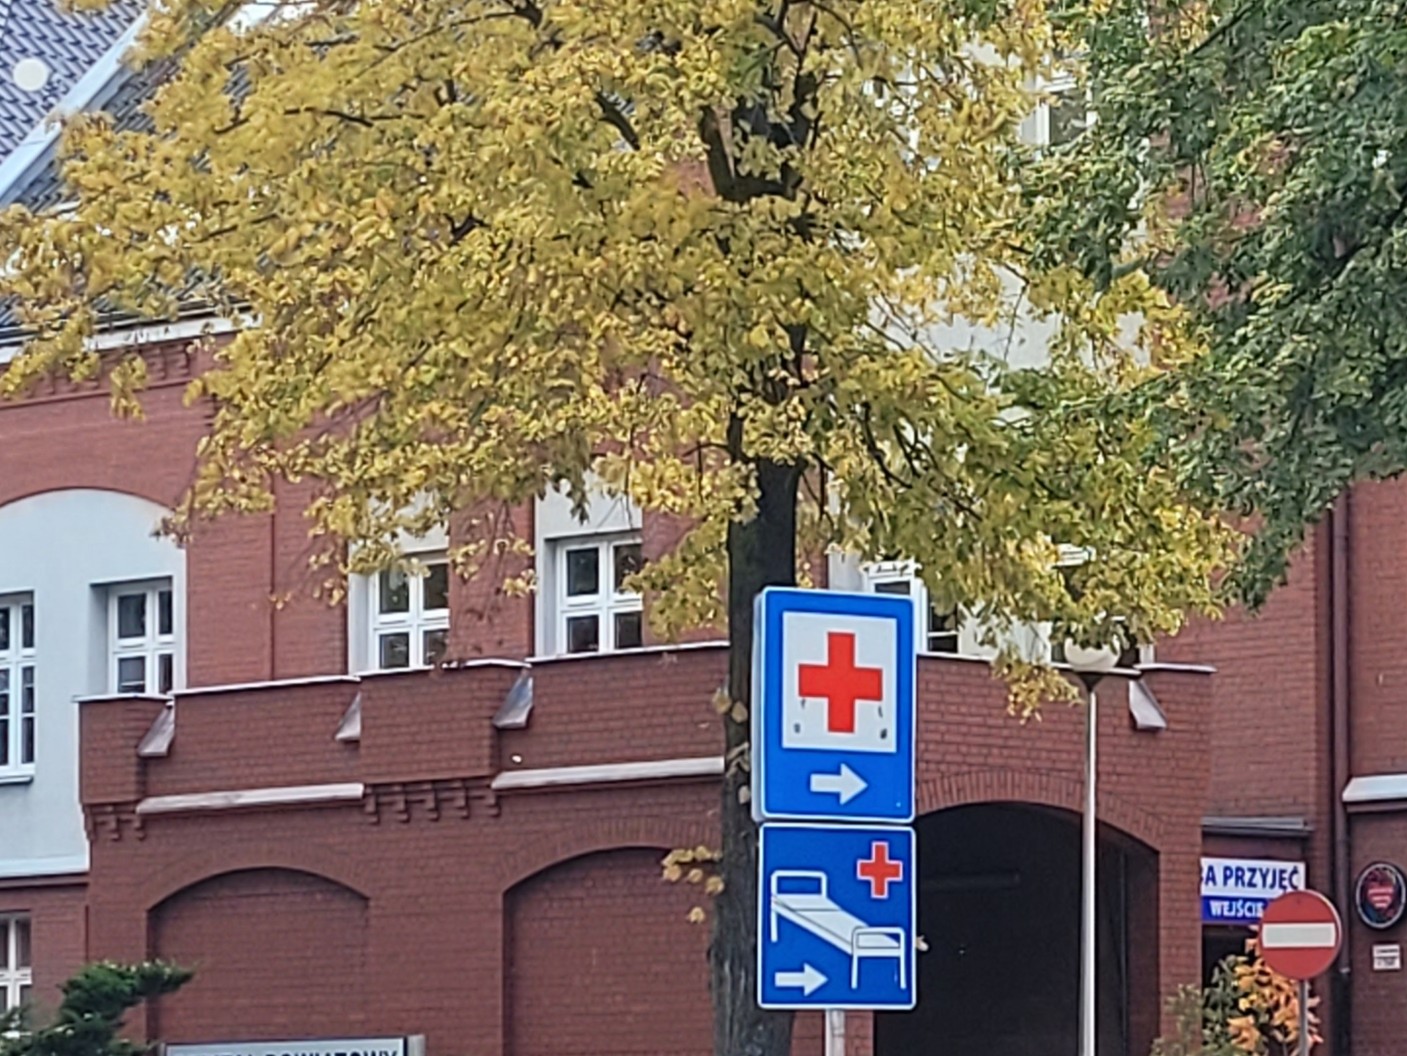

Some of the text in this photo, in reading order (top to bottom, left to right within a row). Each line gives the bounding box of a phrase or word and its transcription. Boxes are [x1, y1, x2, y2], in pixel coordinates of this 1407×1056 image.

[1201, 864, 1299, 893] A PRZYJĘĆ
[1209, 899, 1264, 918] WEJŚCIE
